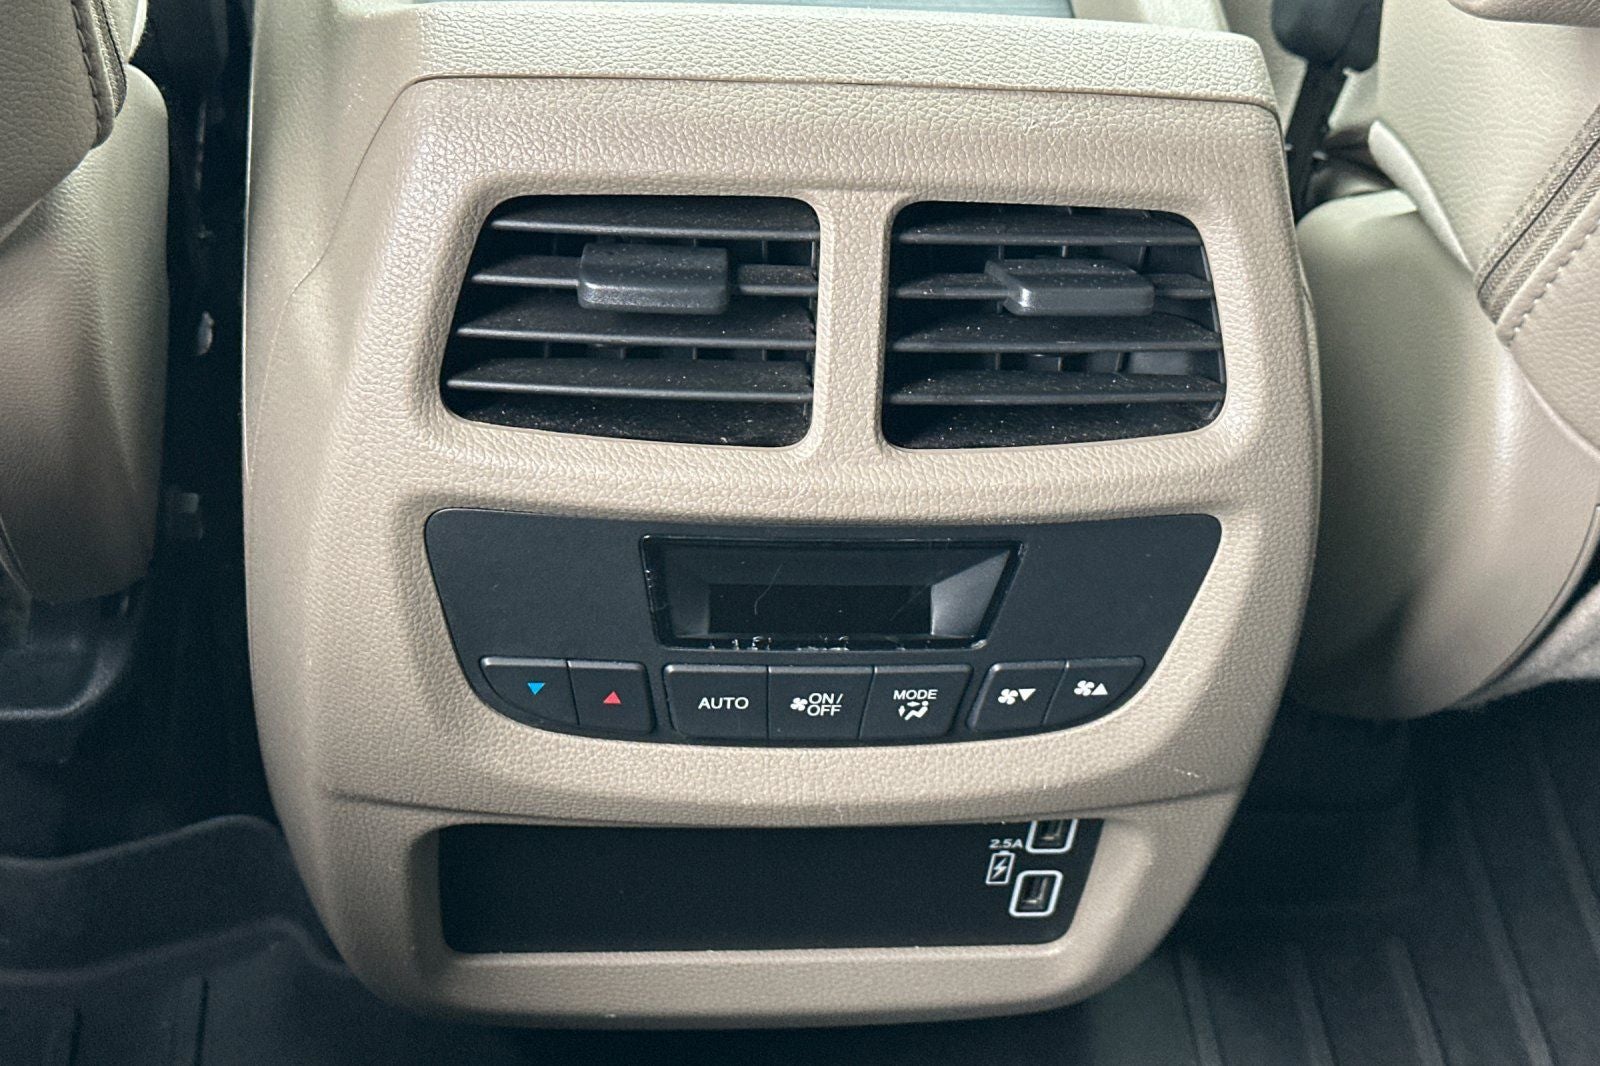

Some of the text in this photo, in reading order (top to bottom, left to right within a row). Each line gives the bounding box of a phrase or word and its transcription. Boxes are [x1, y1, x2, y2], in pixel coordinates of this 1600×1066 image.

[893, 689, 938, 700] MODE
[698, 697, 749, 709] AUTO
[807, 704, 842, 716] OFF
[988, 838, 1023, 849] 2.5A
